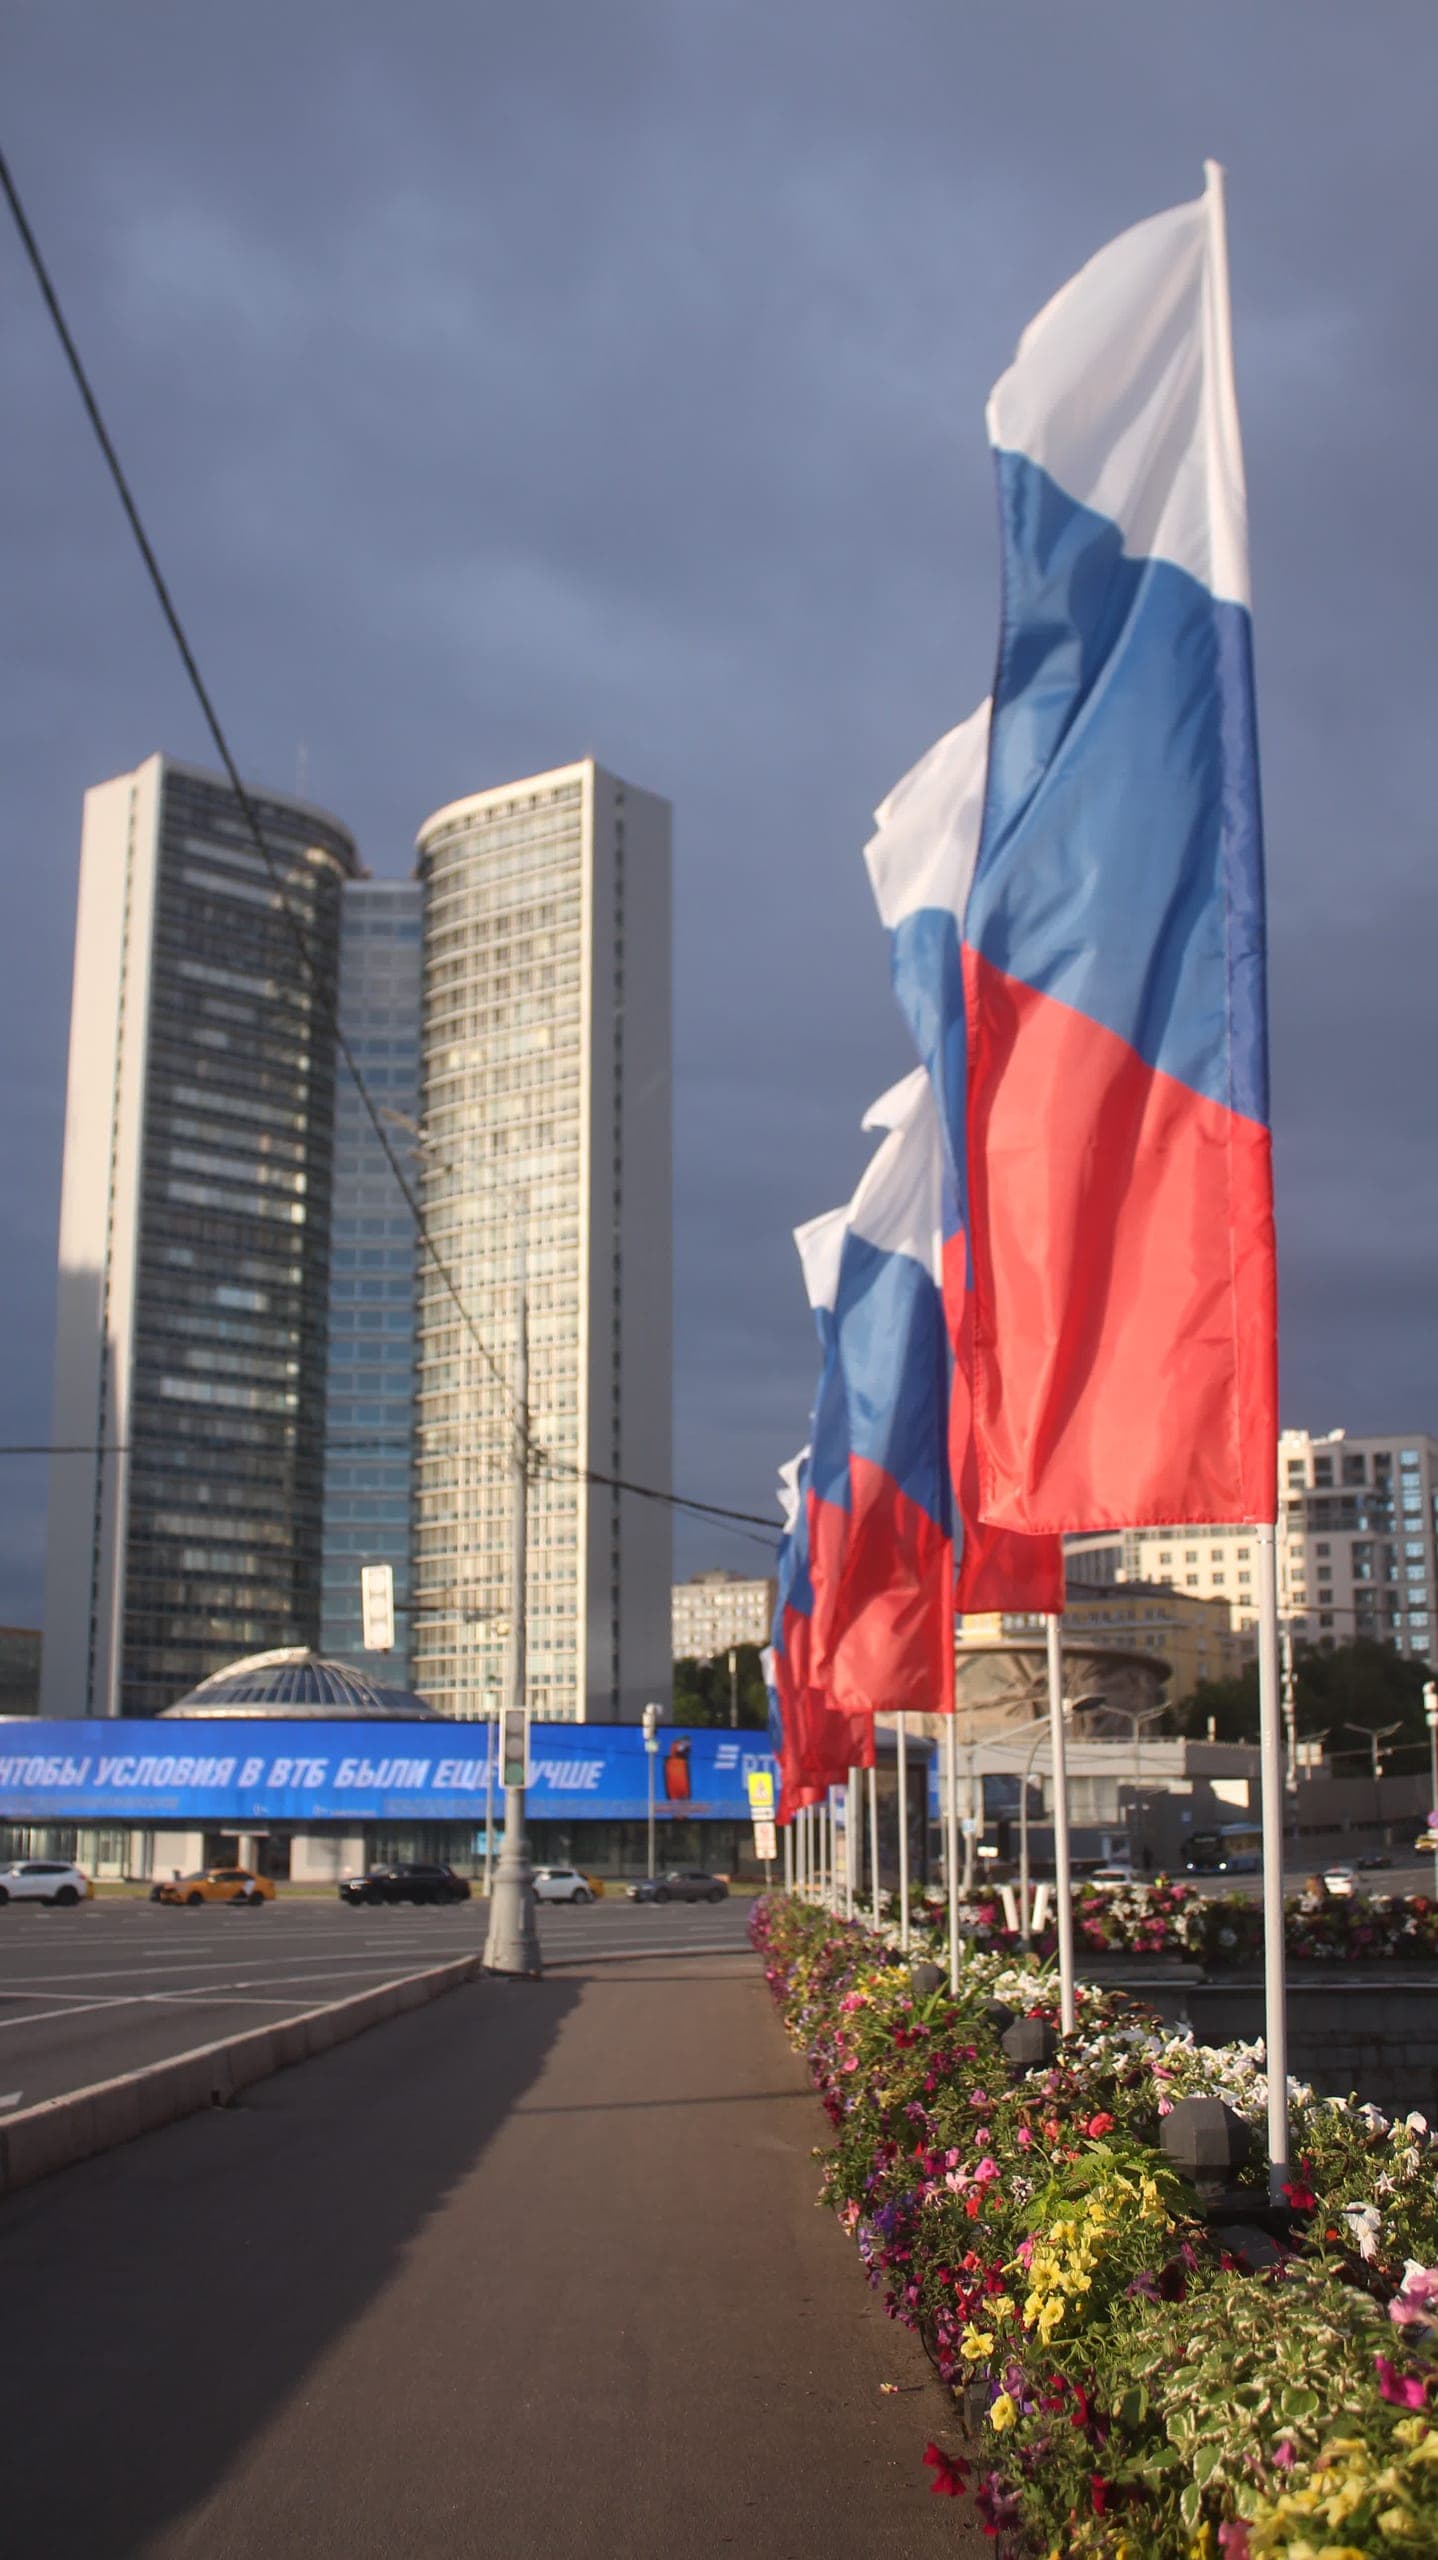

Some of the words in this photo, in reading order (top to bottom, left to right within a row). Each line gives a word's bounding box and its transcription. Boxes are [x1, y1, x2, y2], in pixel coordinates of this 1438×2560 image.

[93, 1756, 236, 1787] УСЛОВИЯ
[237, 1757, 265, 1787] В
[267, 1757, 330, 1788] ВТБ
[333, 1758, 430, 1789] БЫЛИ
[527, 1759, 606, 1789] УЧШЕ
